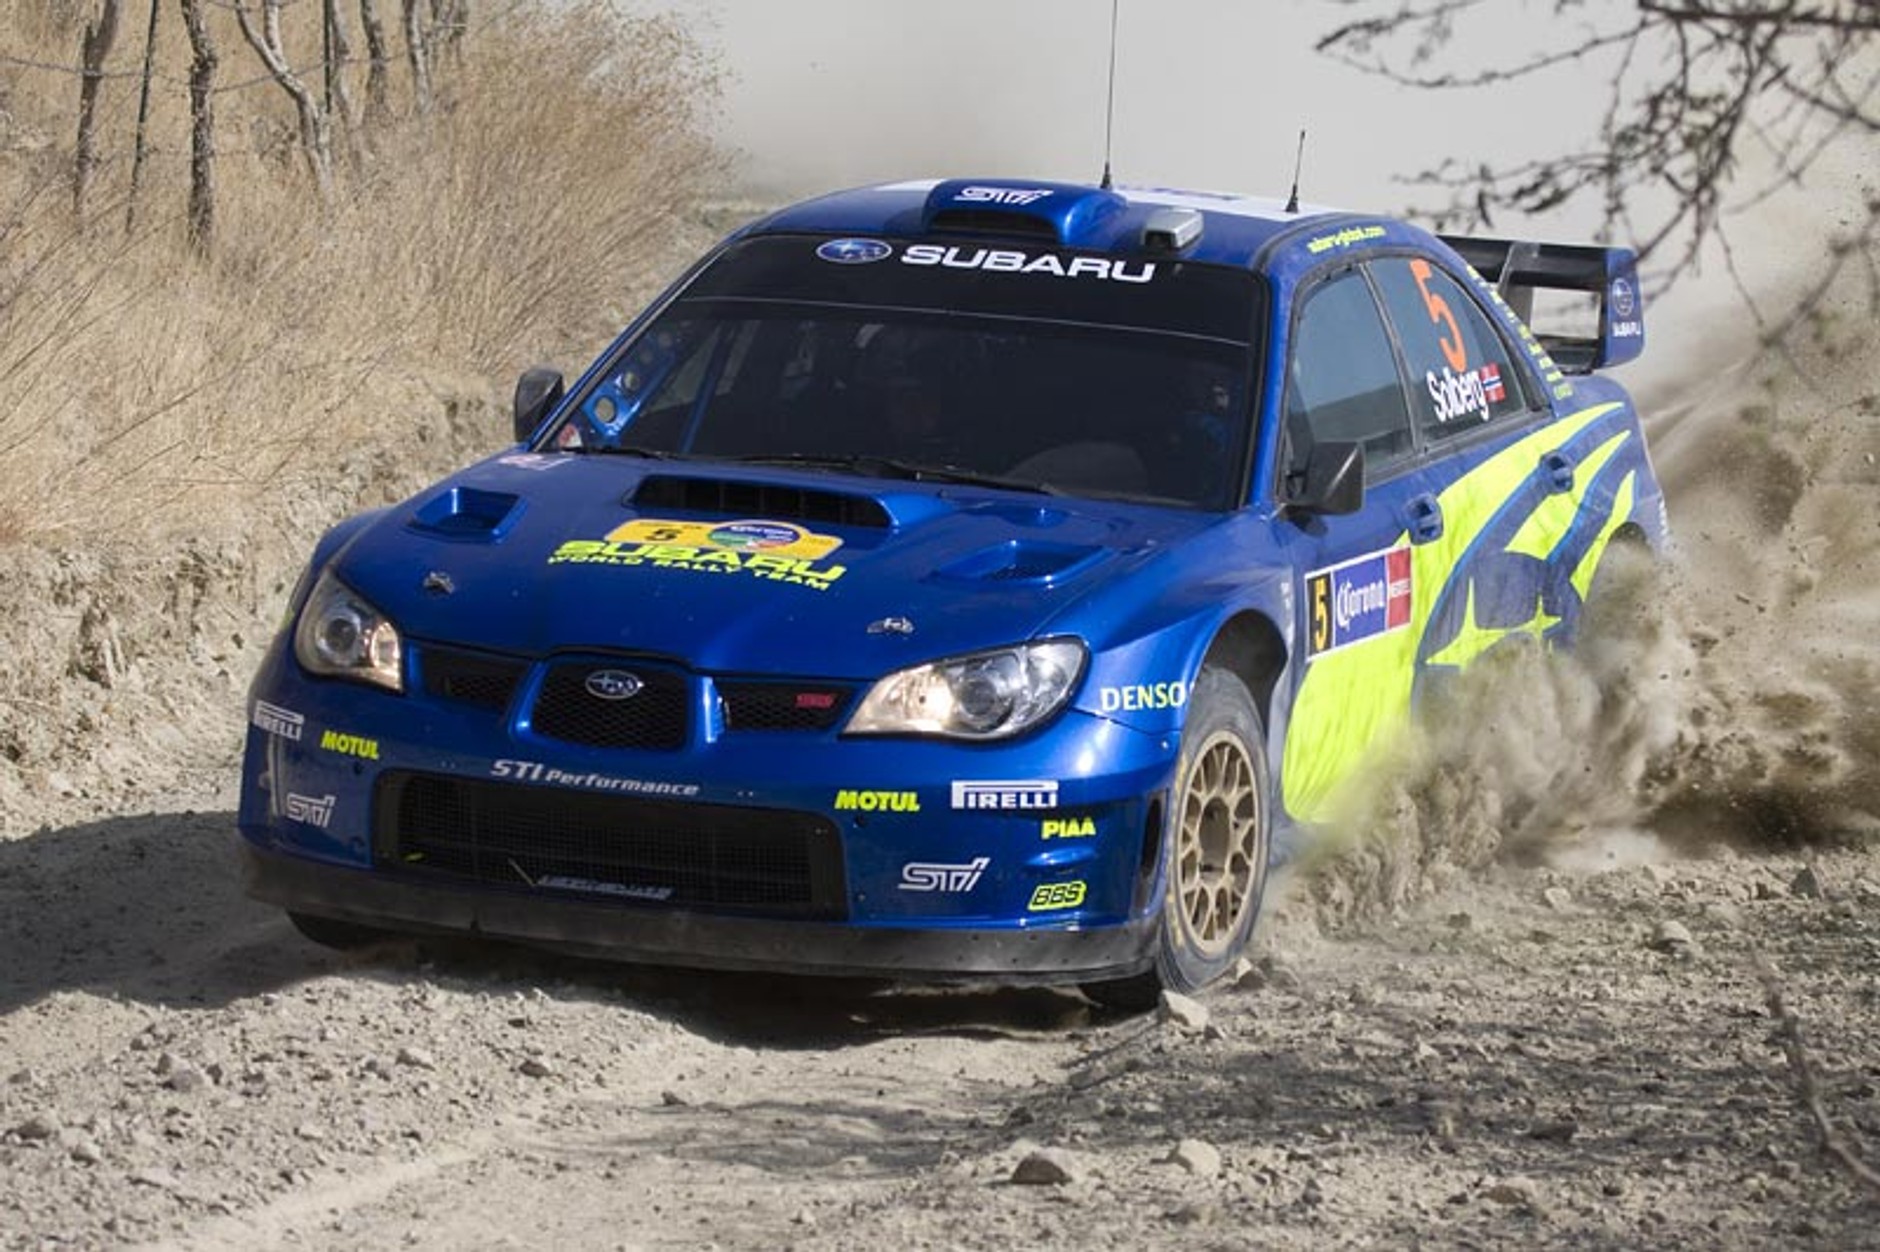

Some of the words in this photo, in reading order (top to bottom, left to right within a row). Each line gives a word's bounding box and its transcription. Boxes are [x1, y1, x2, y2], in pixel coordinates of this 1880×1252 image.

[901, 244, 1155, 283] SUBARU
[1410, 259, 1466, 372] 5
[1426, 367, 1490, 422] Solberg
[645, 529, 683, 541] 5
[547, 555, 643, 565] WORLD
[652, 559, 742, 573] RALLY
[754, 569, 831, 591] TEAM
[555, 540, 847, 581] SUBARU
[1314, 578, 1327, 651] 5
[1101, 681, 1186, 711] DENSO
[253, 700, 304, 741] PIRELLI
[321, 730, 379, 760] MOTUL
[491, 759, 545, 781] STI
[545, 769, 700, 796] Performance
[951, 779, 1059, 809] PIRELLI
[835, 790, 921, 812] MOTUL
[1041, 816, 1096, 840] PIAA
[1031, 881, 1082, 906] BBS
